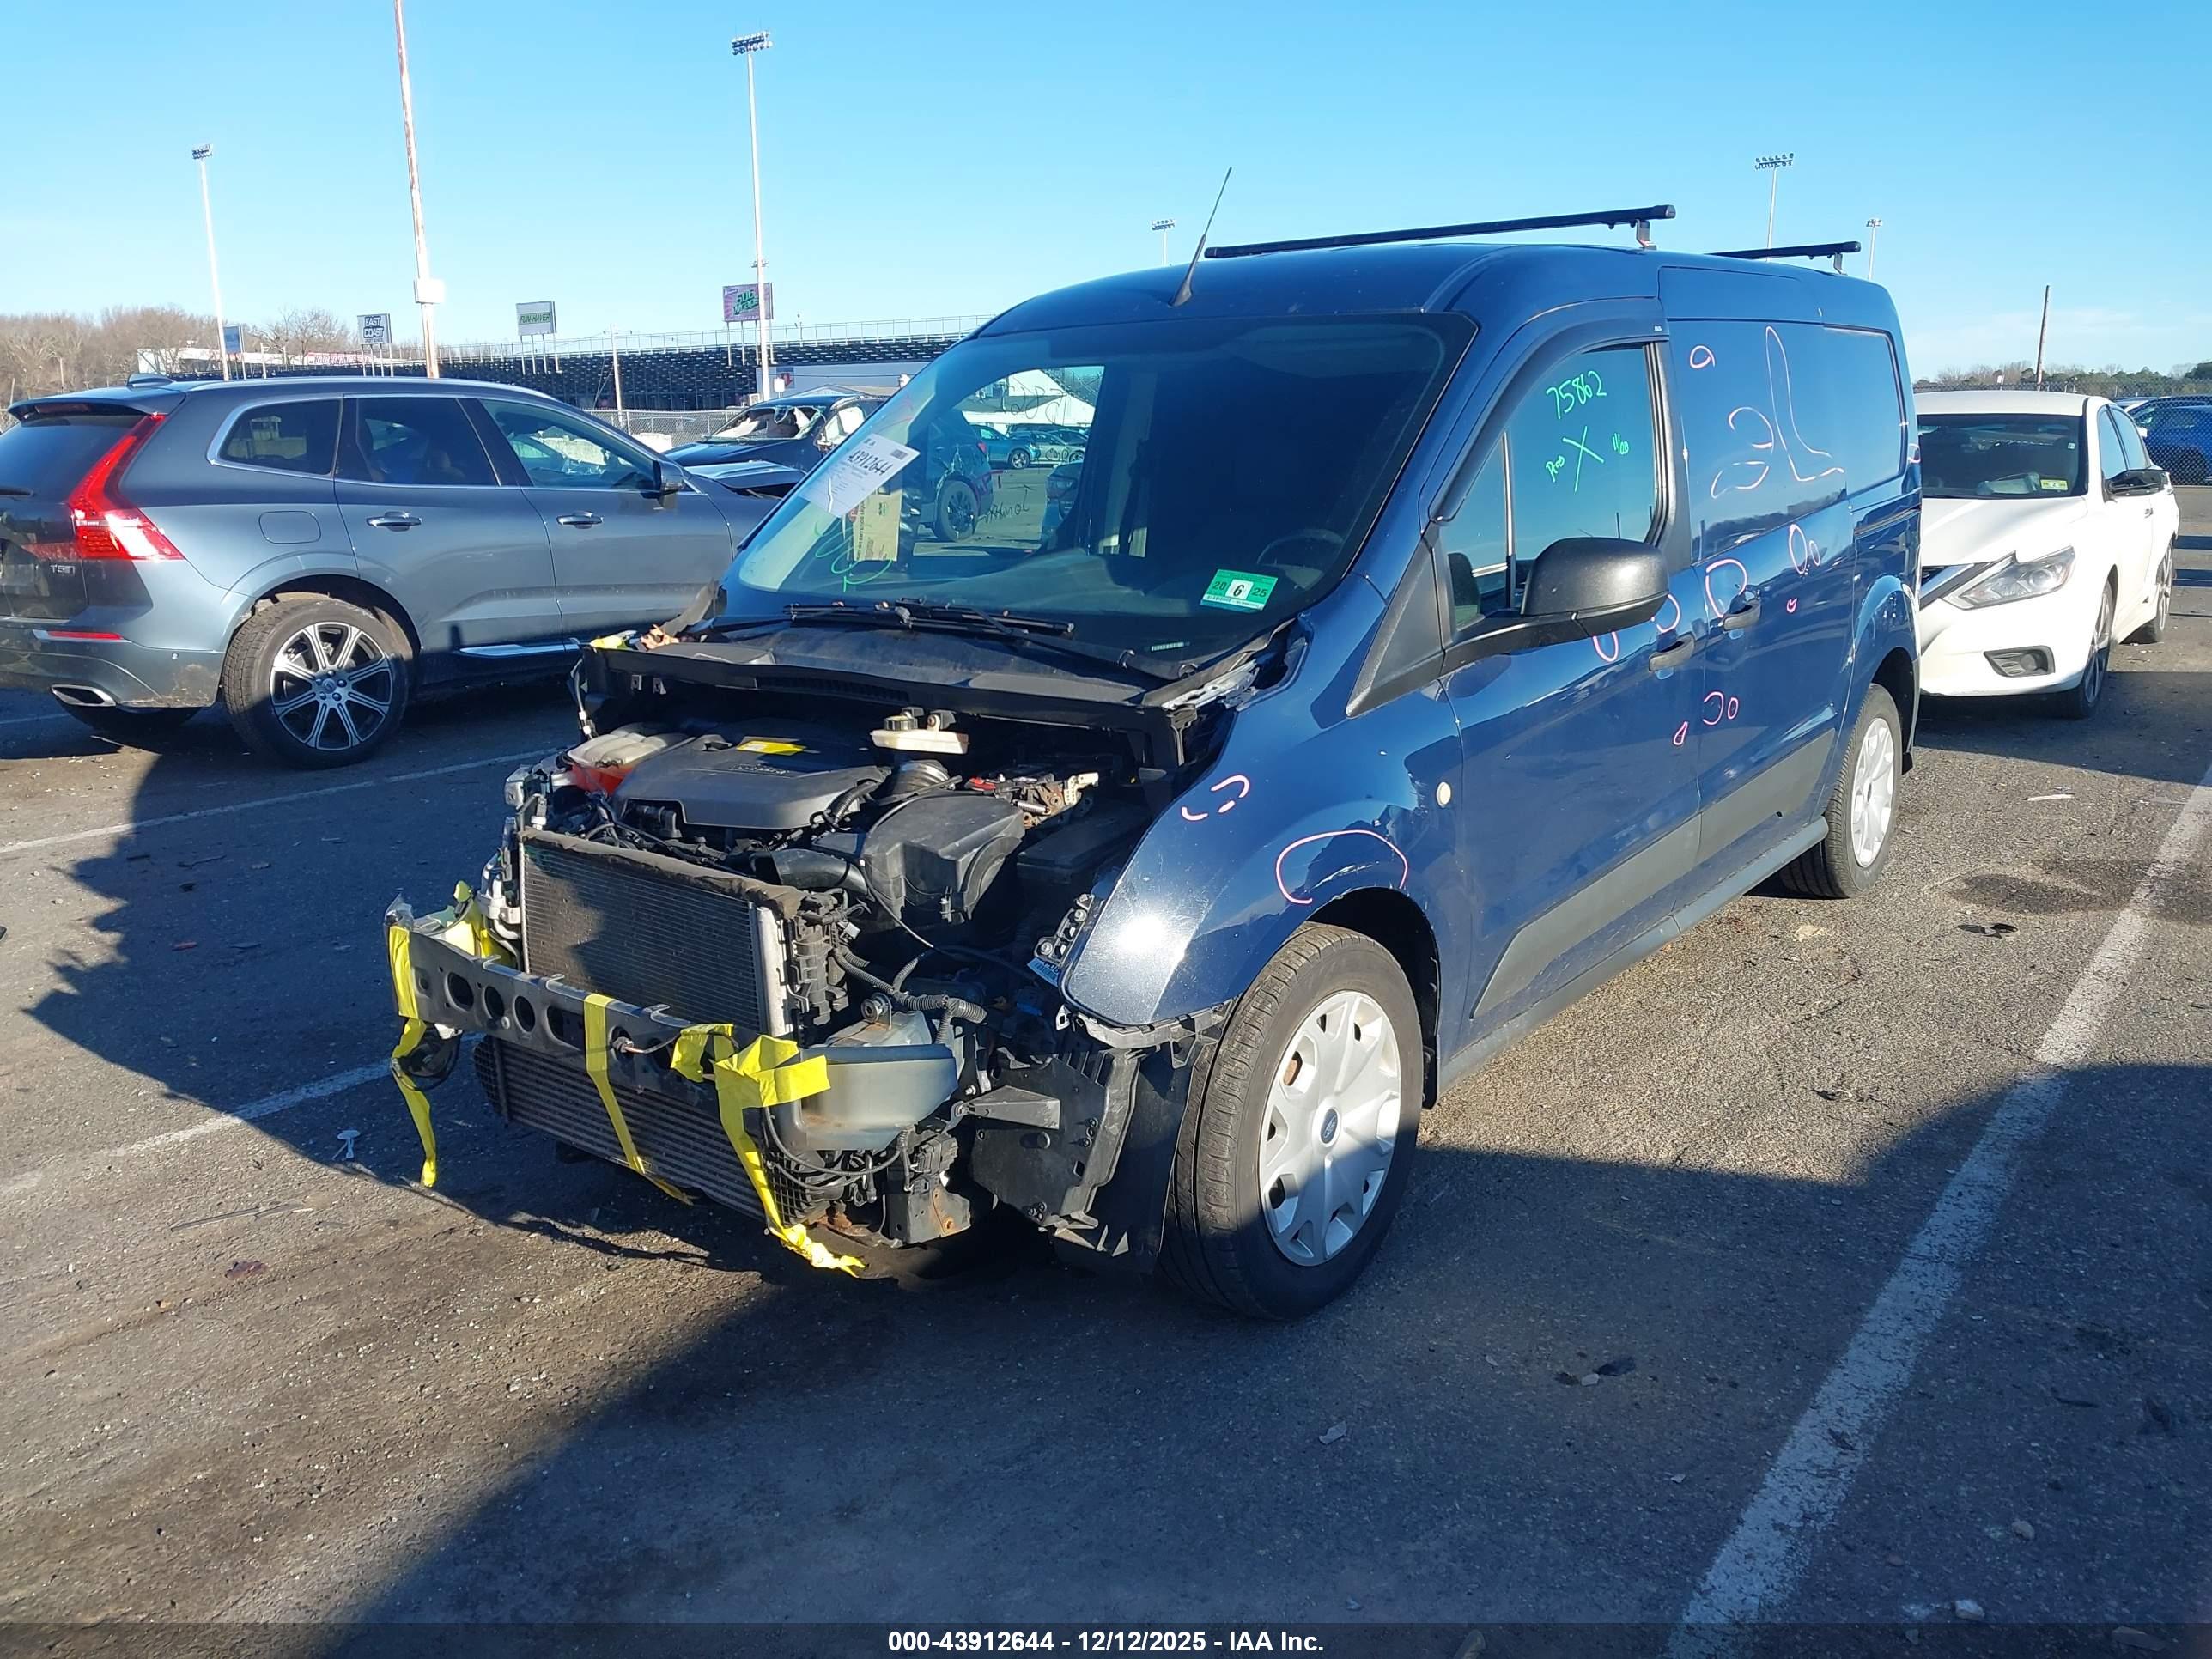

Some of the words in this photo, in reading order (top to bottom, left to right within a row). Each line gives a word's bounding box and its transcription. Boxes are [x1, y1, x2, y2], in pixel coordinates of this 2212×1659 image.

[364, 316, 381, 326] EAST
[1545, 370, 1607, 420] 75862
[847, 448, 894, 476] 43912644
[1212, 580, 1227, 591] 20
[1233, 584, 1245, 597] 6
[1251, 587, 1267, 598] 25
